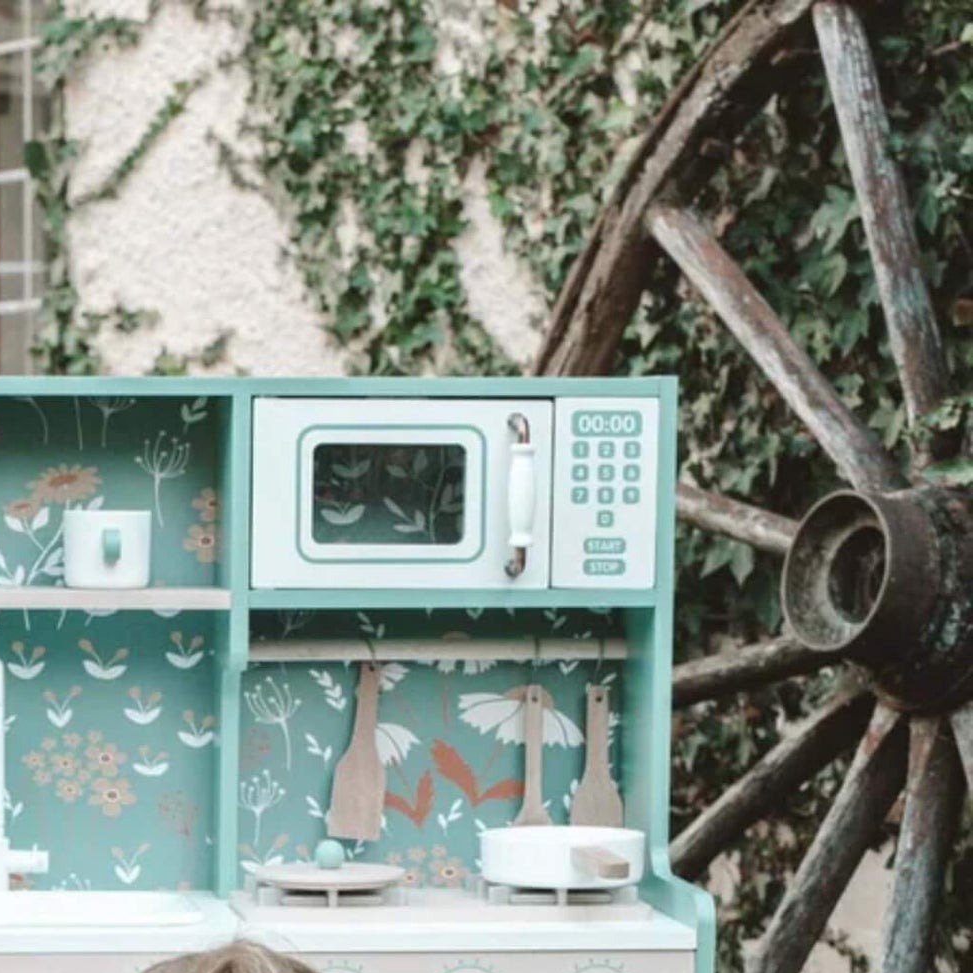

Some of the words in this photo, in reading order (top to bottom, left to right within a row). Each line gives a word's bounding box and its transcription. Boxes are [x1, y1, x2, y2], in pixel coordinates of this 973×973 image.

[578, 415, 636, 433] 00:00
[588, 540, 622, 551] START
[589, 561, 620, 572] STOP
